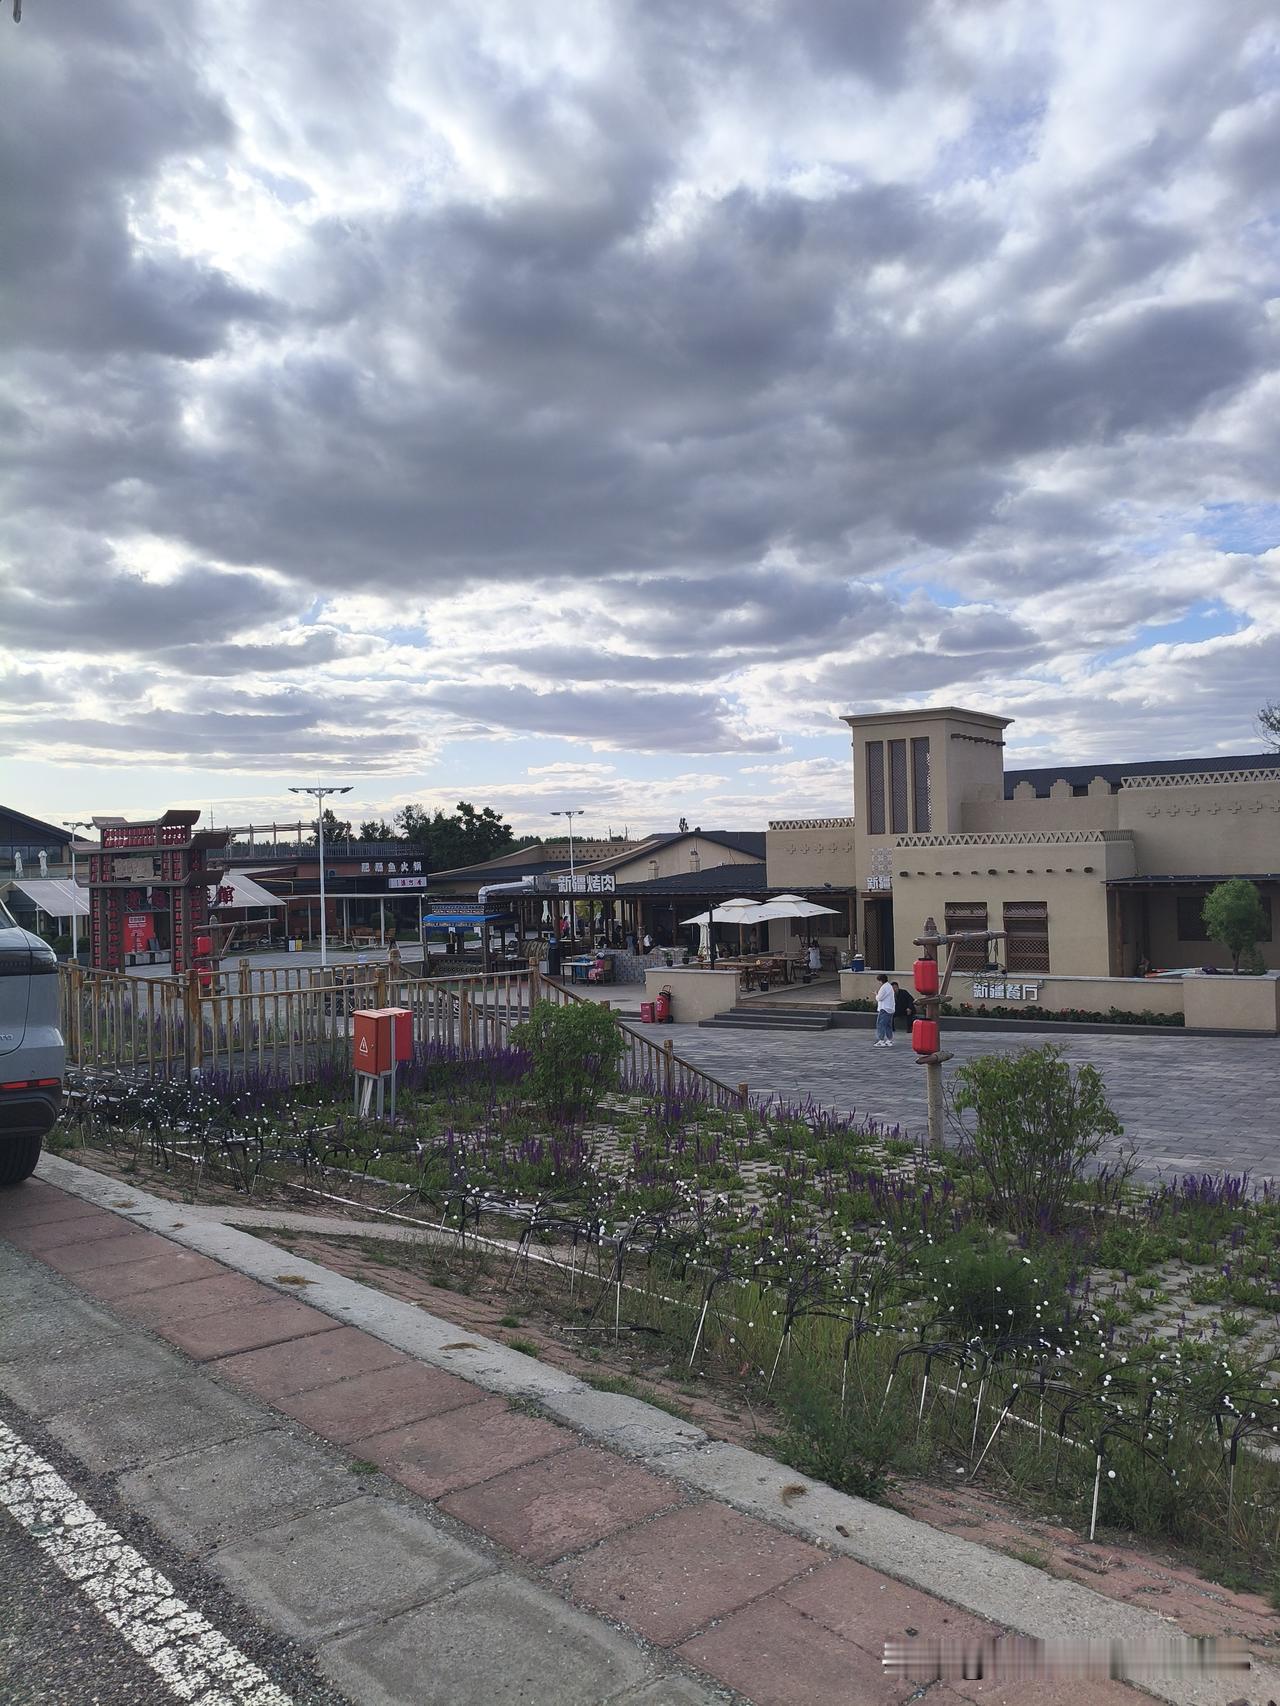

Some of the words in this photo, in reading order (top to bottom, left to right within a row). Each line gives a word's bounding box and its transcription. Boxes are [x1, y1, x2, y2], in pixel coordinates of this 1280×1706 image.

[558, 875, 615, 893] 新疆烤肉
[973, 983, 1038, 1001] 新疆餐厅
